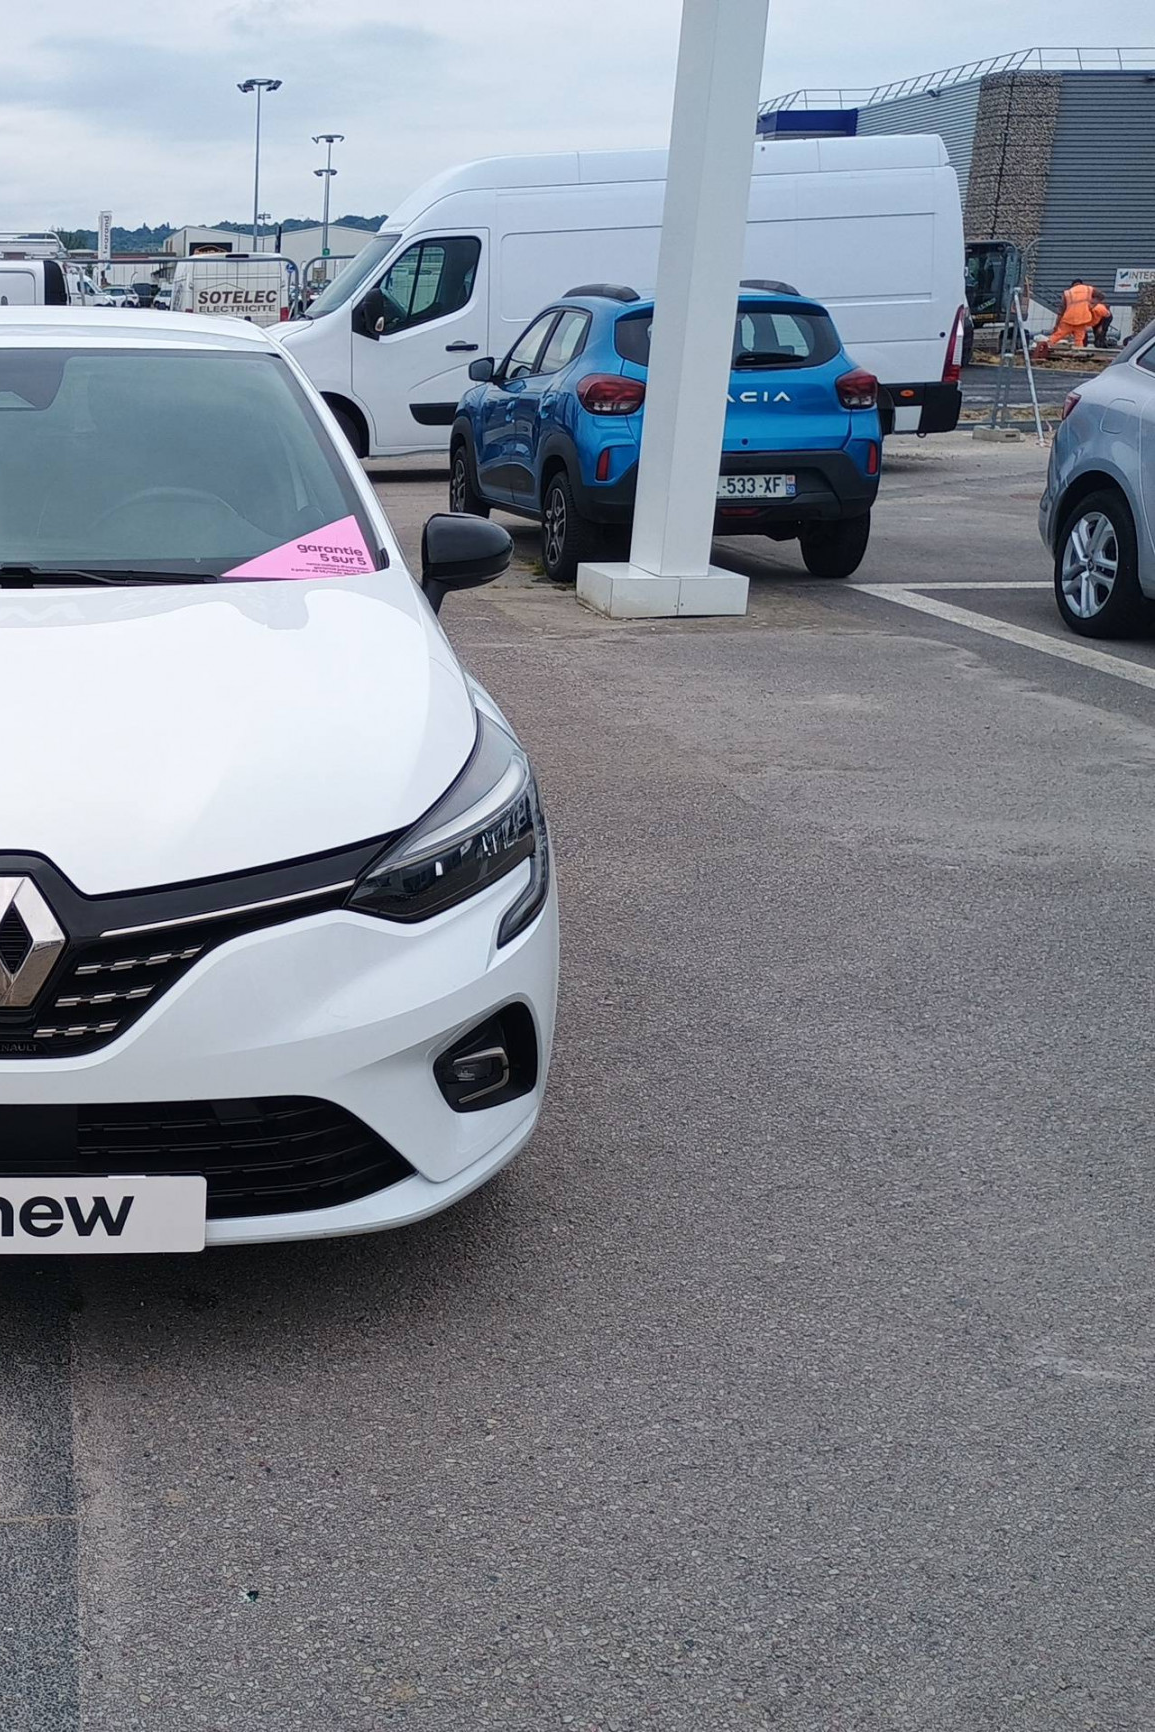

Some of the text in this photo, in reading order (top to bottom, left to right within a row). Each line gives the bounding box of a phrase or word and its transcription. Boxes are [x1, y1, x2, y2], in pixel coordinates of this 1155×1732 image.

[198, 290, 277, 304] SOTELEC
[199, 304, 276, 313] ELECTRICITE
[297, 543, 363, 556] garantie
[320, 553, 367, 566] 5 sur 5
